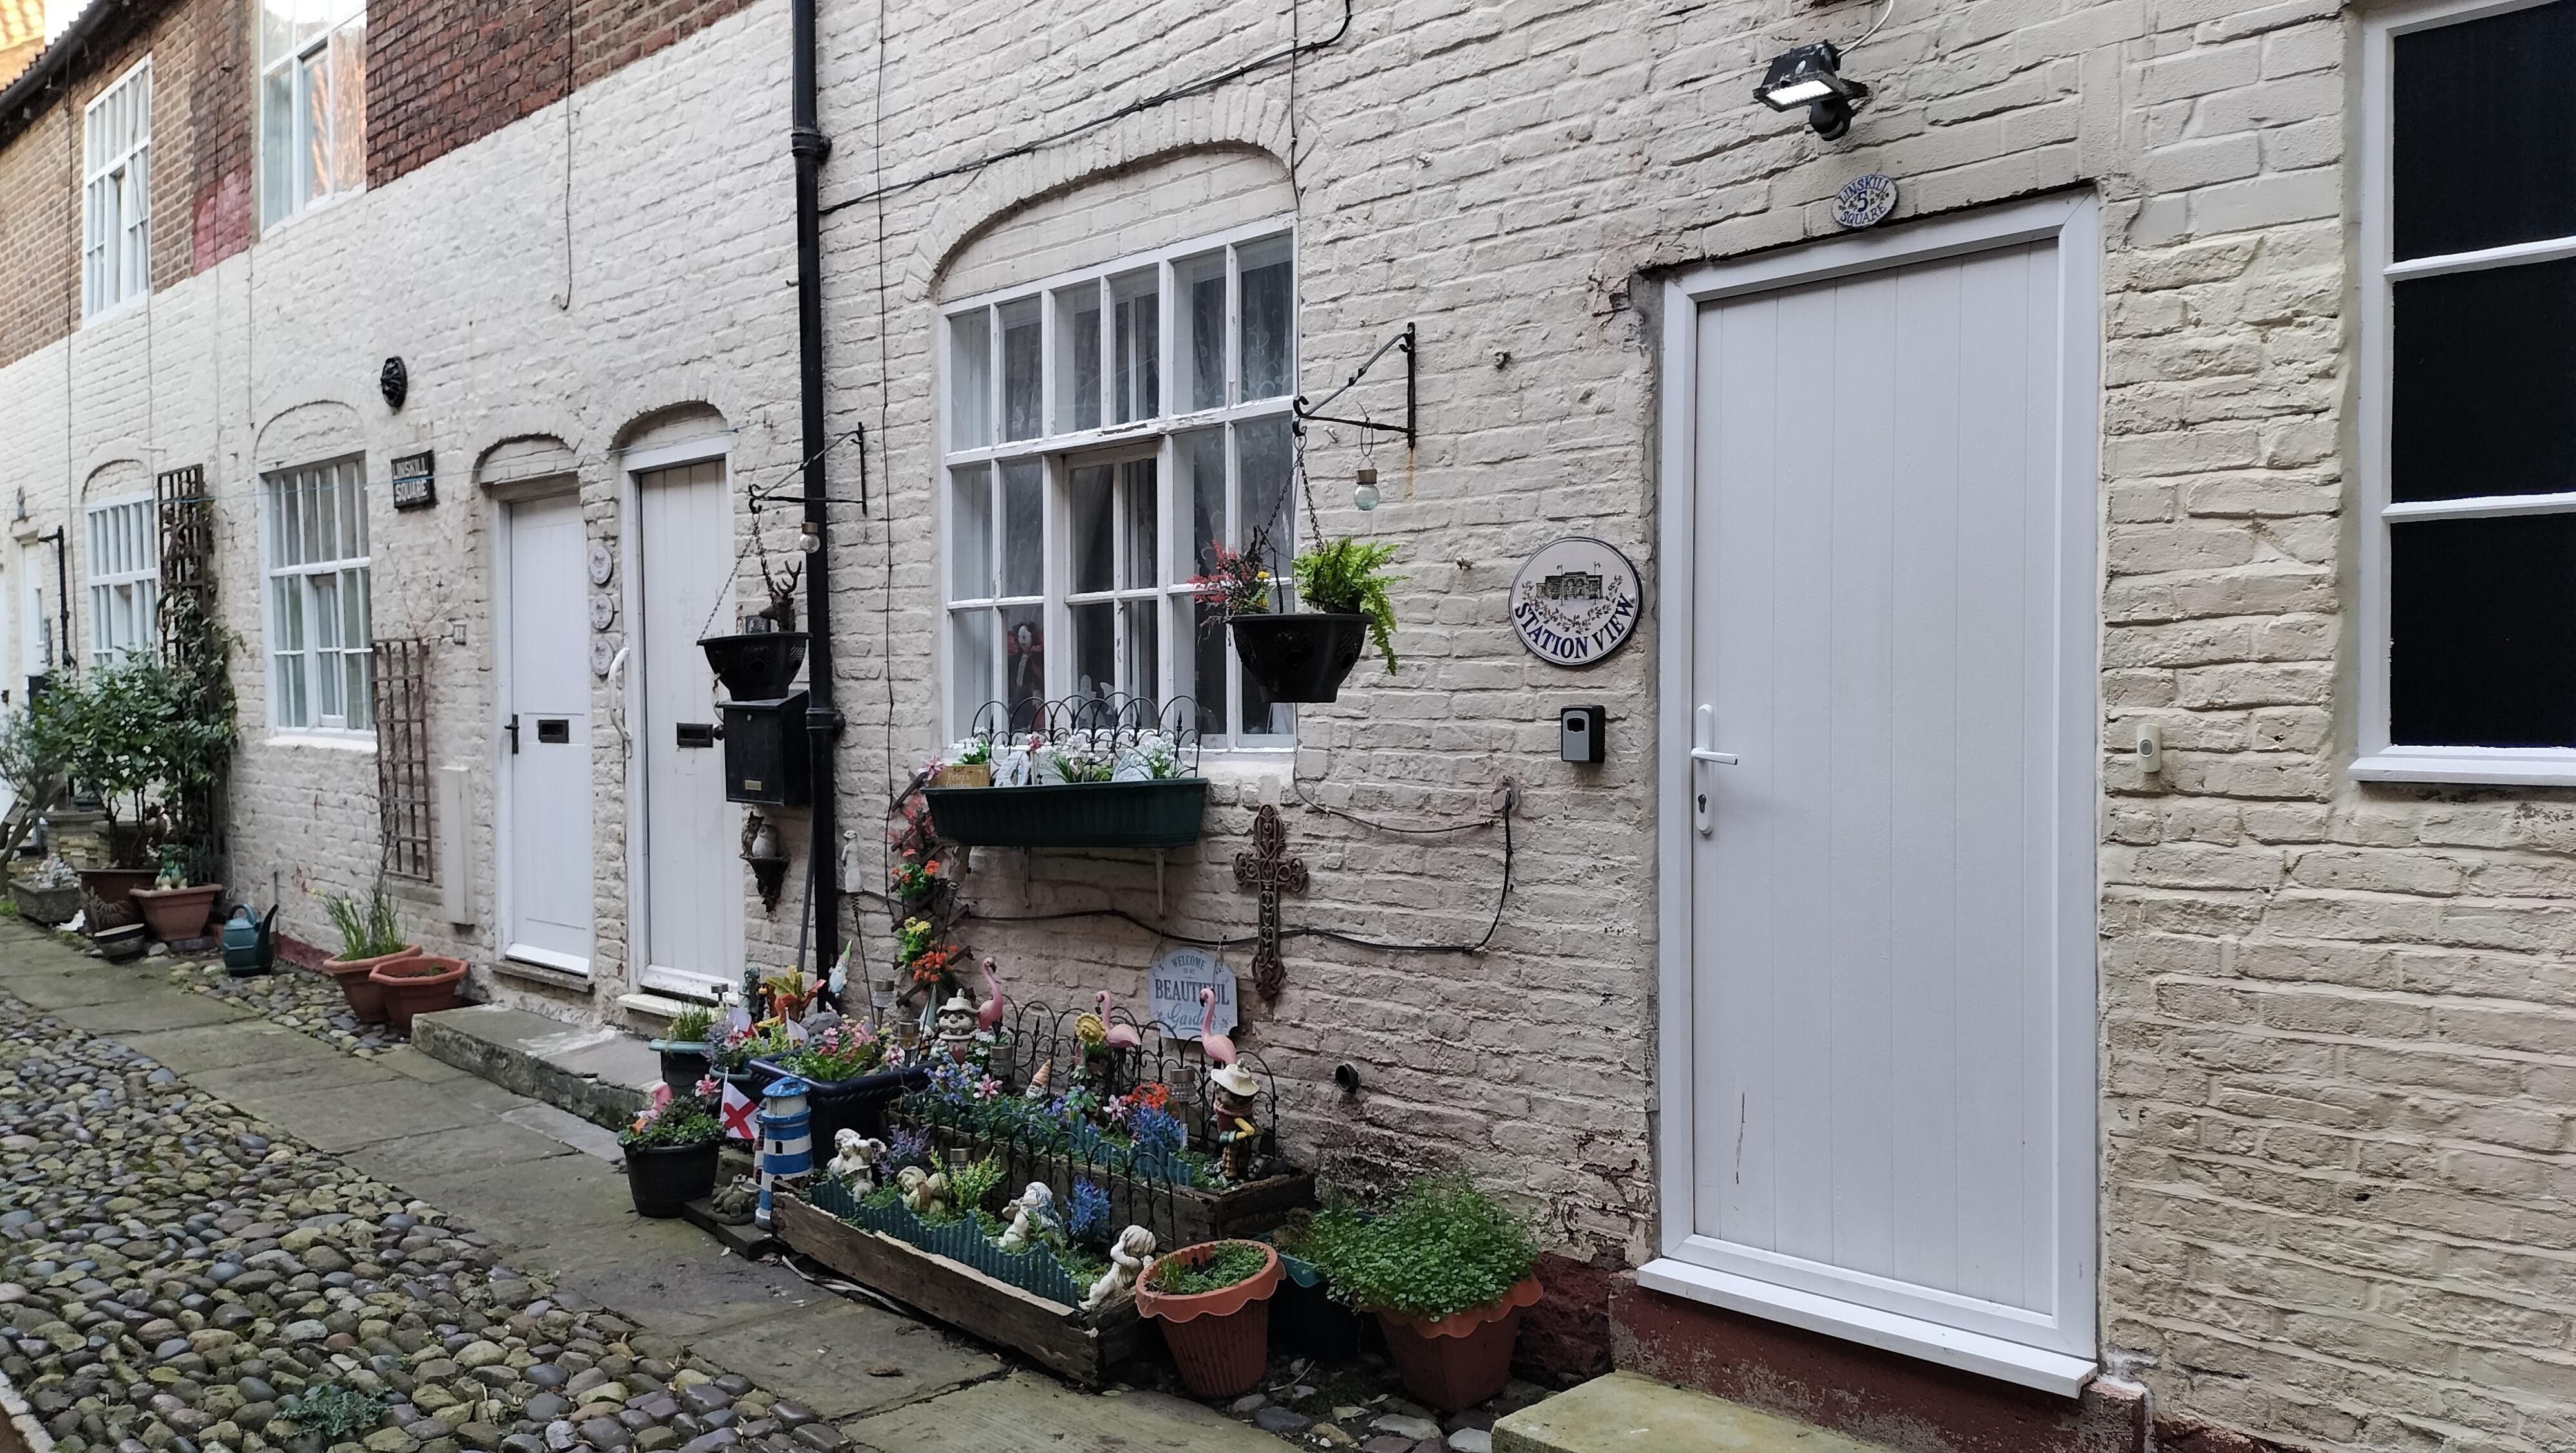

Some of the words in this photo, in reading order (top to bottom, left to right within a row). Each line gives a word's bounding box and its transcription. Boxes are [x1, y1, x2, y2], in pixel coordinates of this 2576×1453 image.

[1837, 176, 1889, 205] LINSKILL
[1857, 190, 1868, 213] 5
[1840, 202, 1887, 225] SQUARE
[392, 457, 429, 480] LINSKILL
[395, 479, 428, 502] SQUARE
[1515, 602, 1589, 659] STATION
[1592, 593, 1634, 651] VIEW
[1171, 954, 1206, 971] WELCOME
[1155, 978, 1229, 1005] BEAUTUL
